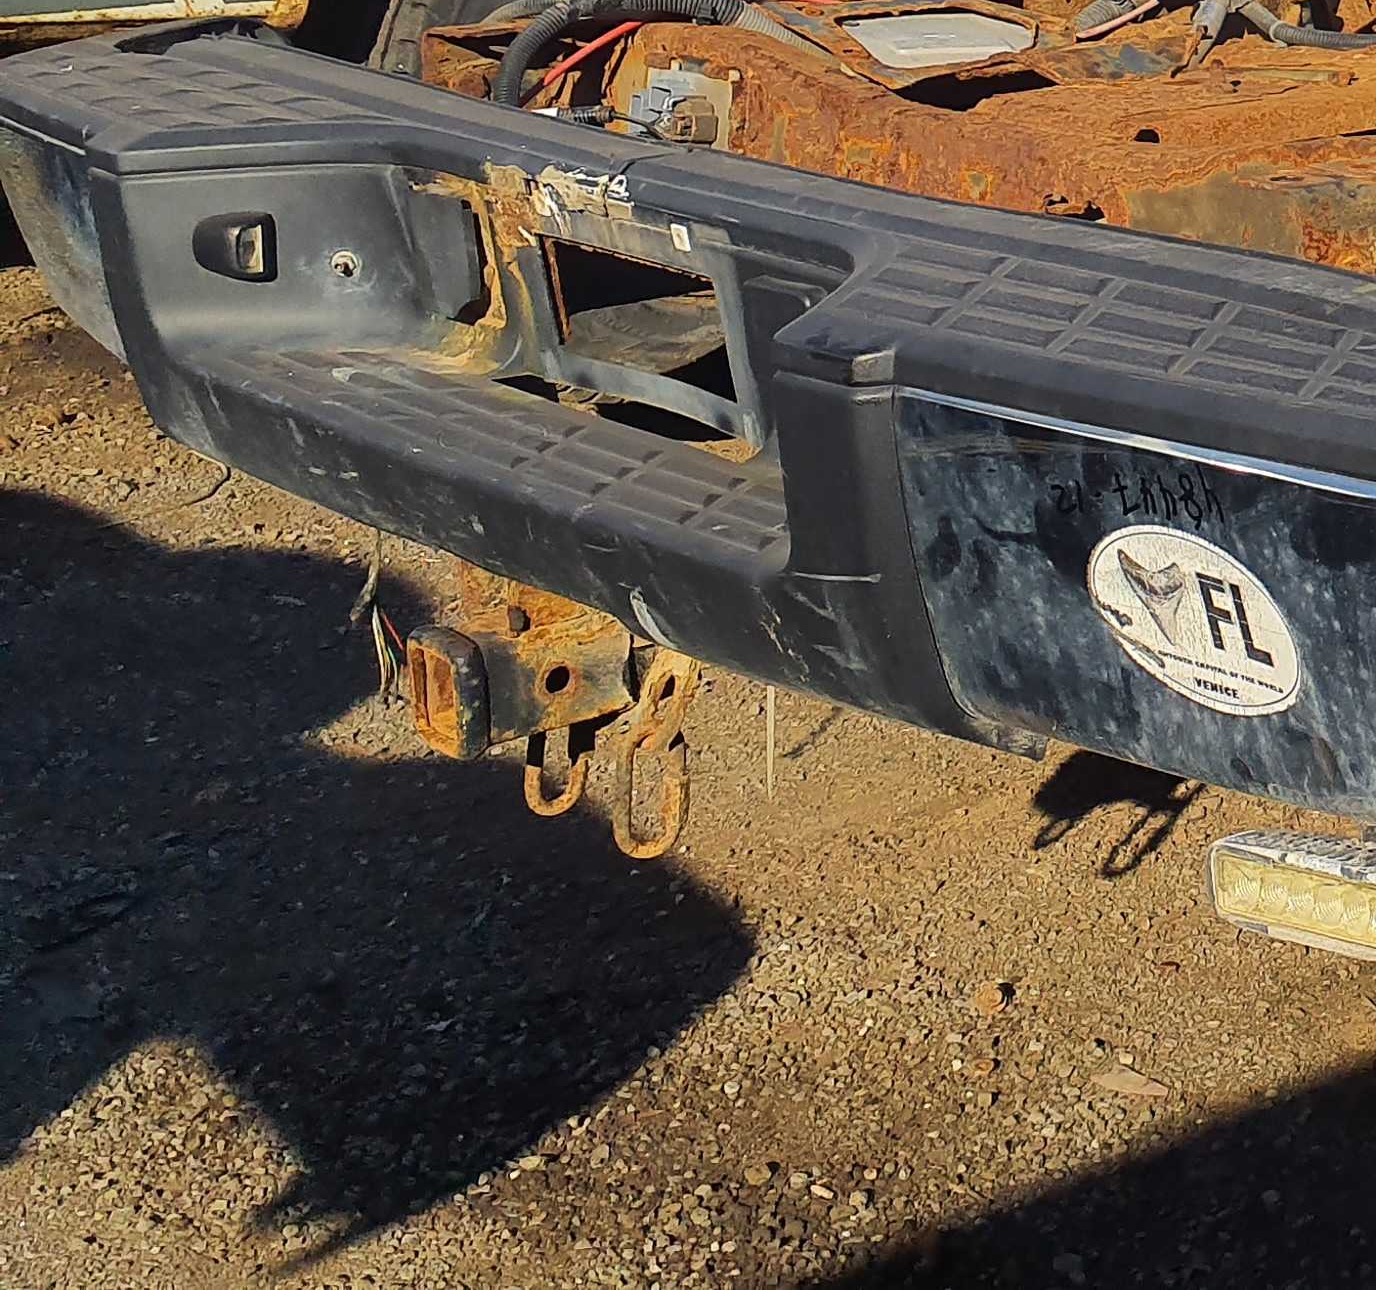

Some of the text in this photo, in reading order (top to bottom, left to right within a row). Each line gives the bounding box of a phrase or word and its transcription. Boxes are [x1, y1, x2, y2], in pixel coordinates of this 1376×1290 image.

[1049, 464, 1225, 530] 48447-12
[1195, 571, 1275, 667] FL
[1193, 676, 1240, 700] VENICE
[1240, 674, 1257, 685] THE
[1257, 679, 1284, 694] WORLD
